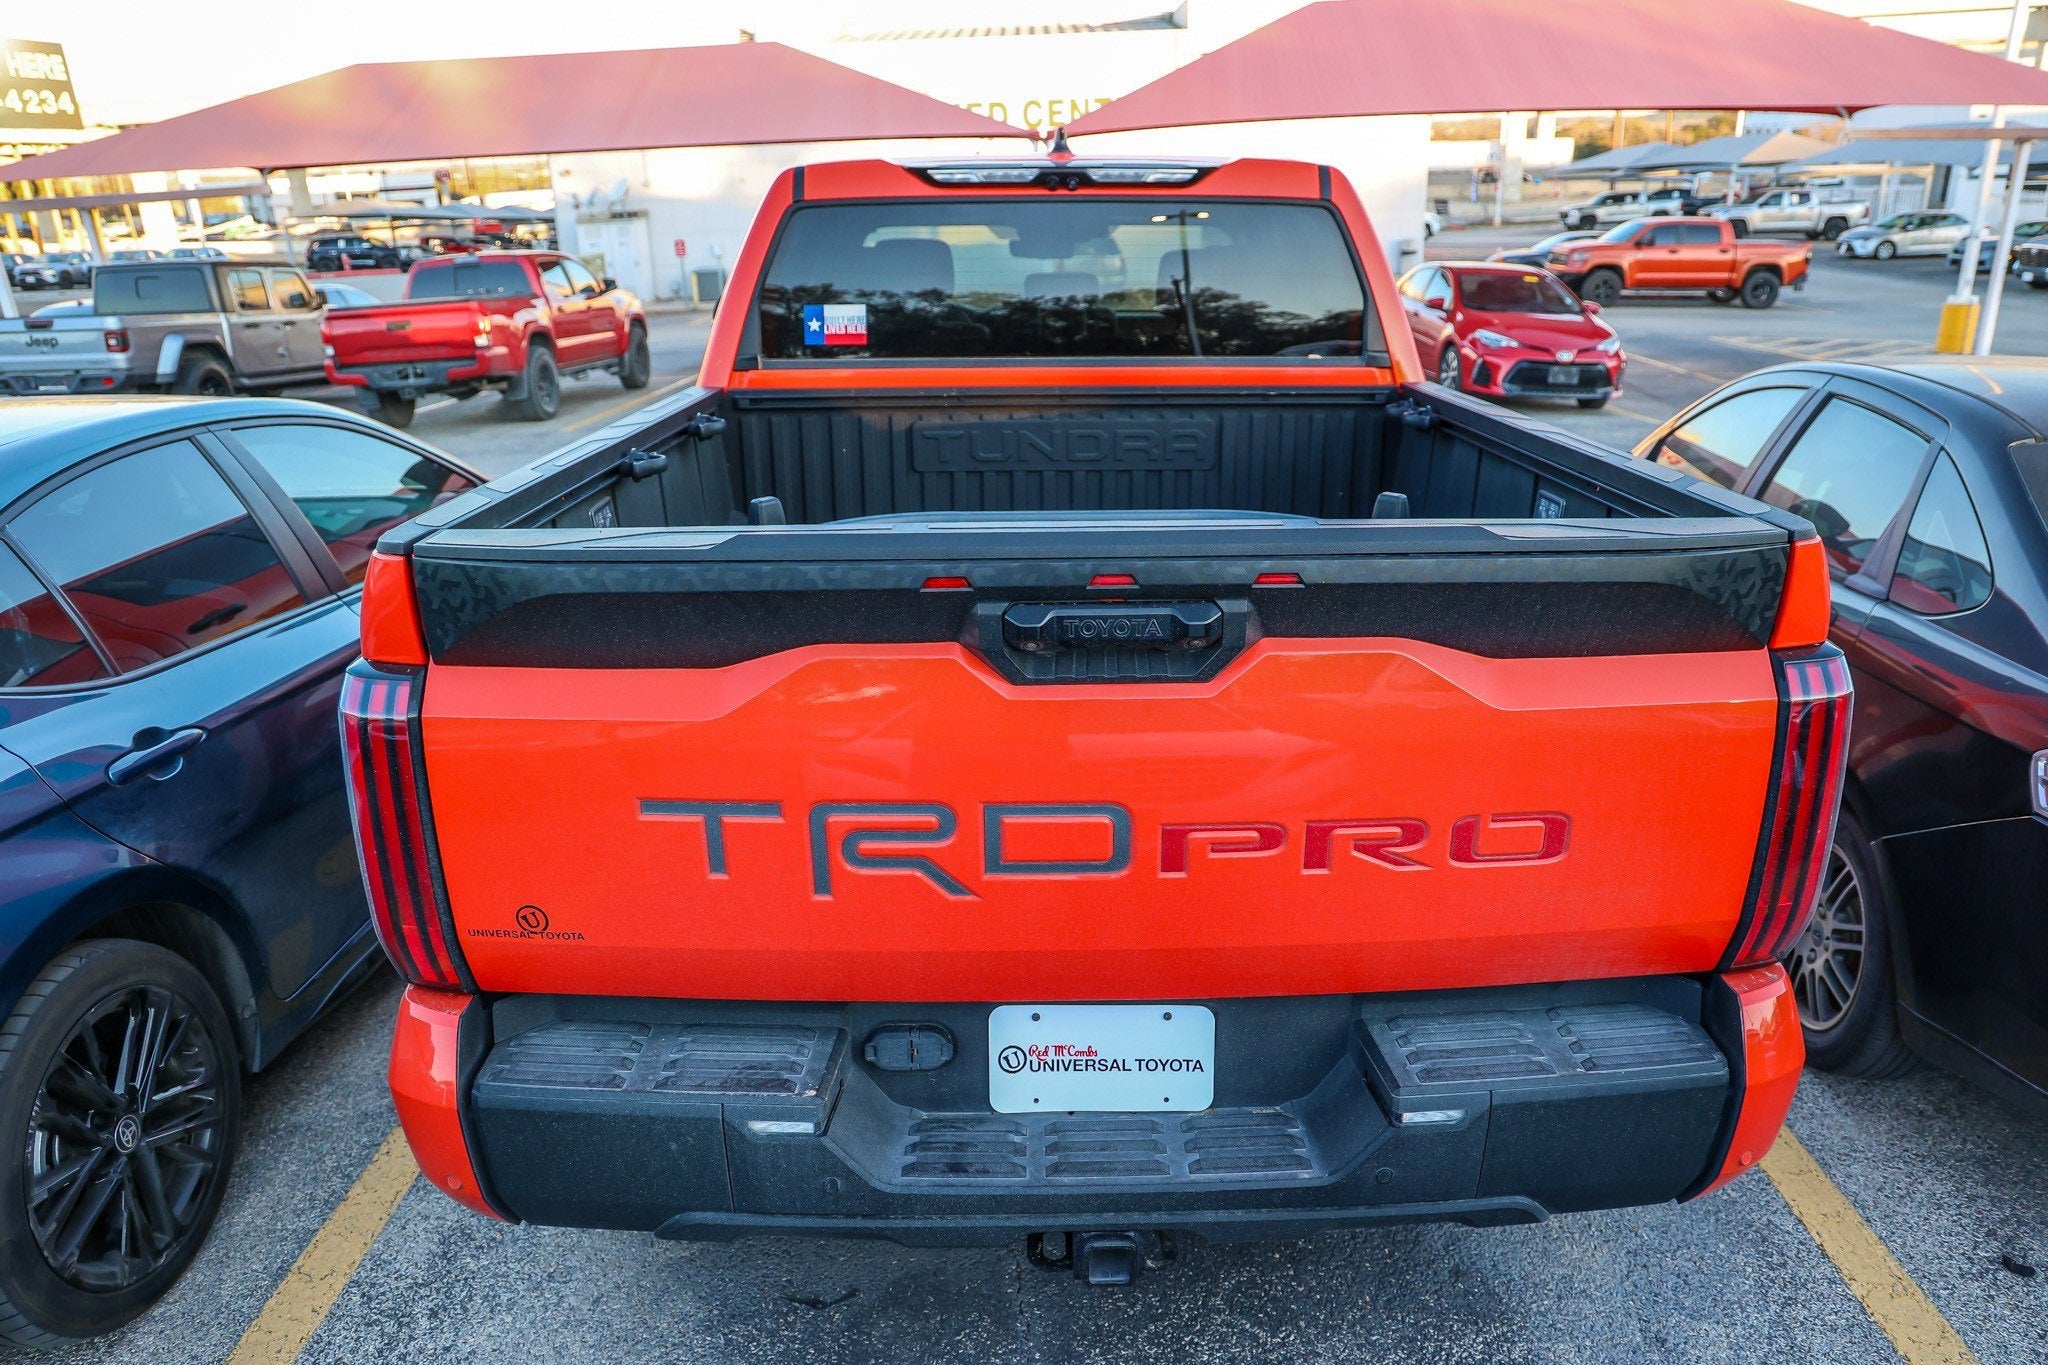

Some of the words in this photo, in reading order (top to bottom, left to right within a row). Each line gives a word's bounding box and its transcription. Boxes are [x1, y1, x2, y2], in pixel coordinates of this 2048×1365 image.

[6, 51, 68, 81] HERE
[847, 323, 867, 334] HERE
[25, 335, 59, 348] Jeep
[922, 429, 1208, 462] TUNDRA
[1063, 618, 1164, 638] TOYOTA
[638, 800, 1132, 899] TRD
[1158, 811, 1571, 877] PRO
[467, 928, 534, 940] UNIVERSAL
[539, 931, 585, 941] TOYOTA
[1028, 1044, 1050, 1062] Red
[1051, 1044, 1099, 1057] McCombs
[1029, 1058, 1132, 1073] UNIVERSAL
[1135, 1058, 1205, 1073] TOYOTA
